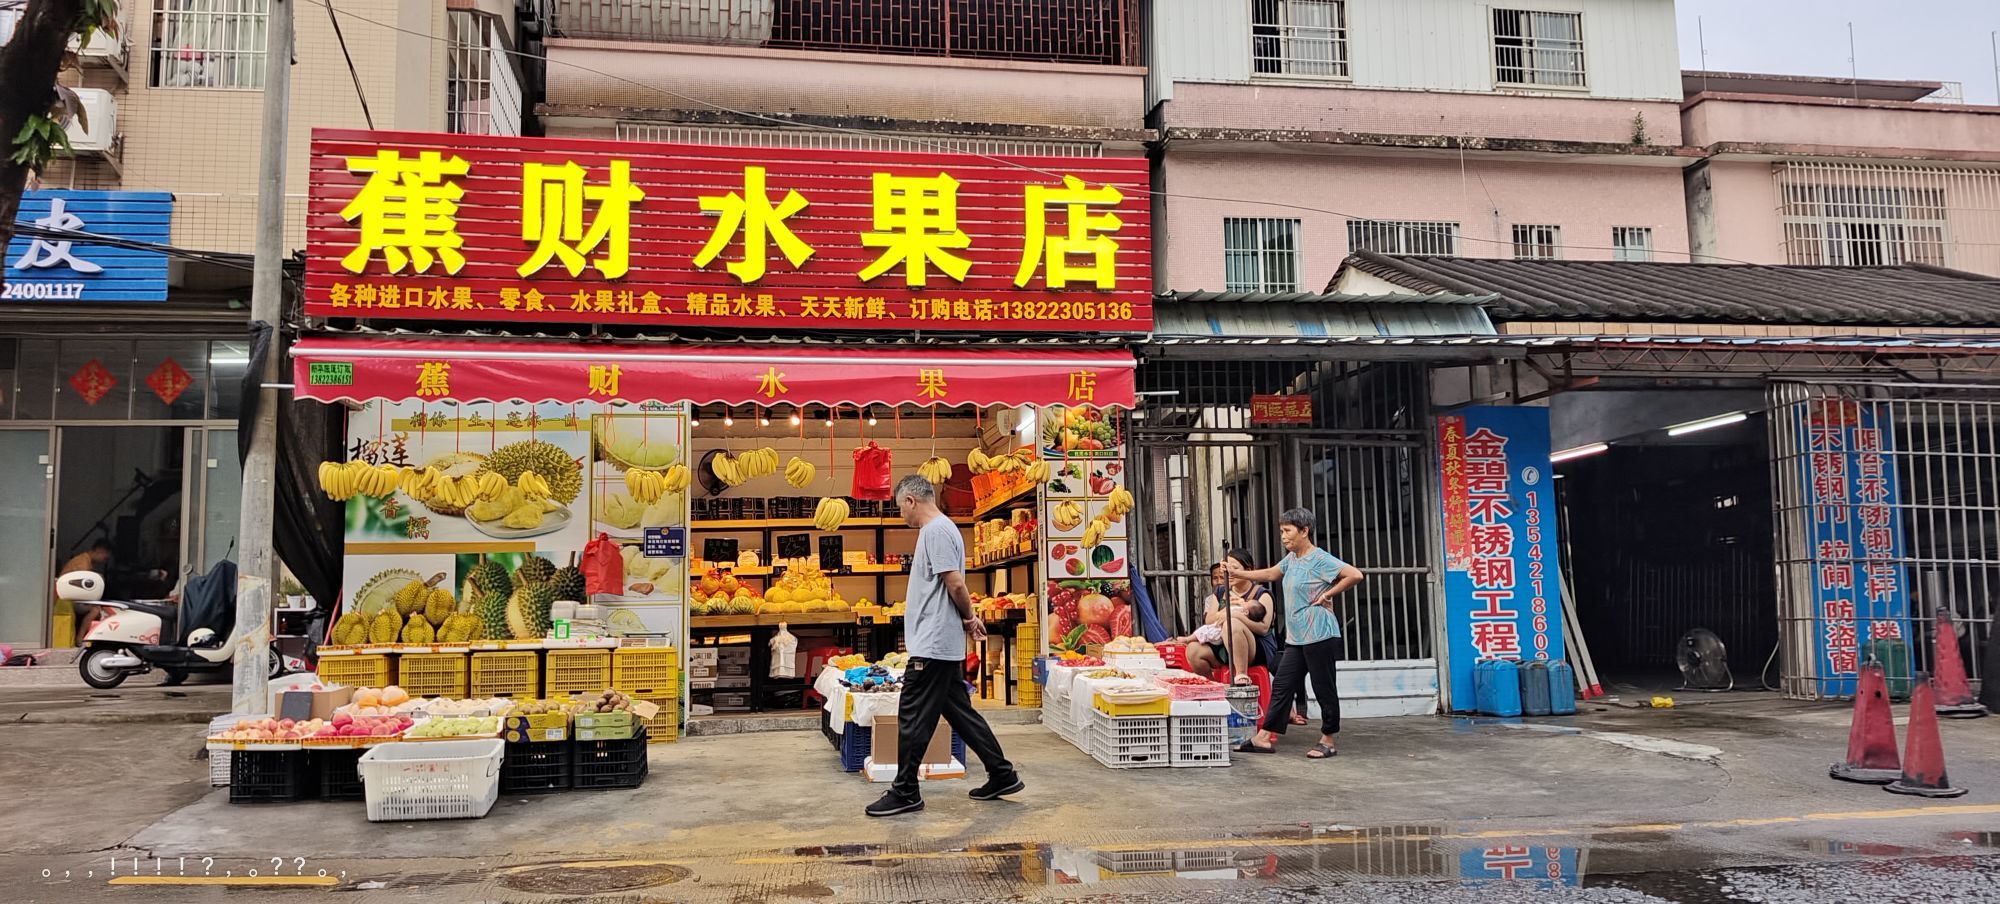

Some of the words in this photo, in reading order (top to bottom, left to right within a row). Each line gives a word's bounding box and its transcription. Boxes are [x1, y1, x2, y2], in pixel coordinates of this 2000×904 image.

[13, 197, 104, 274] 皮
[341, 149, 1124, 290] 蕉财水果店
[416, 361, 1096, 401] 蕉财水果店
[1464, 427, 1522, 664] 金碧不锈钢工程
